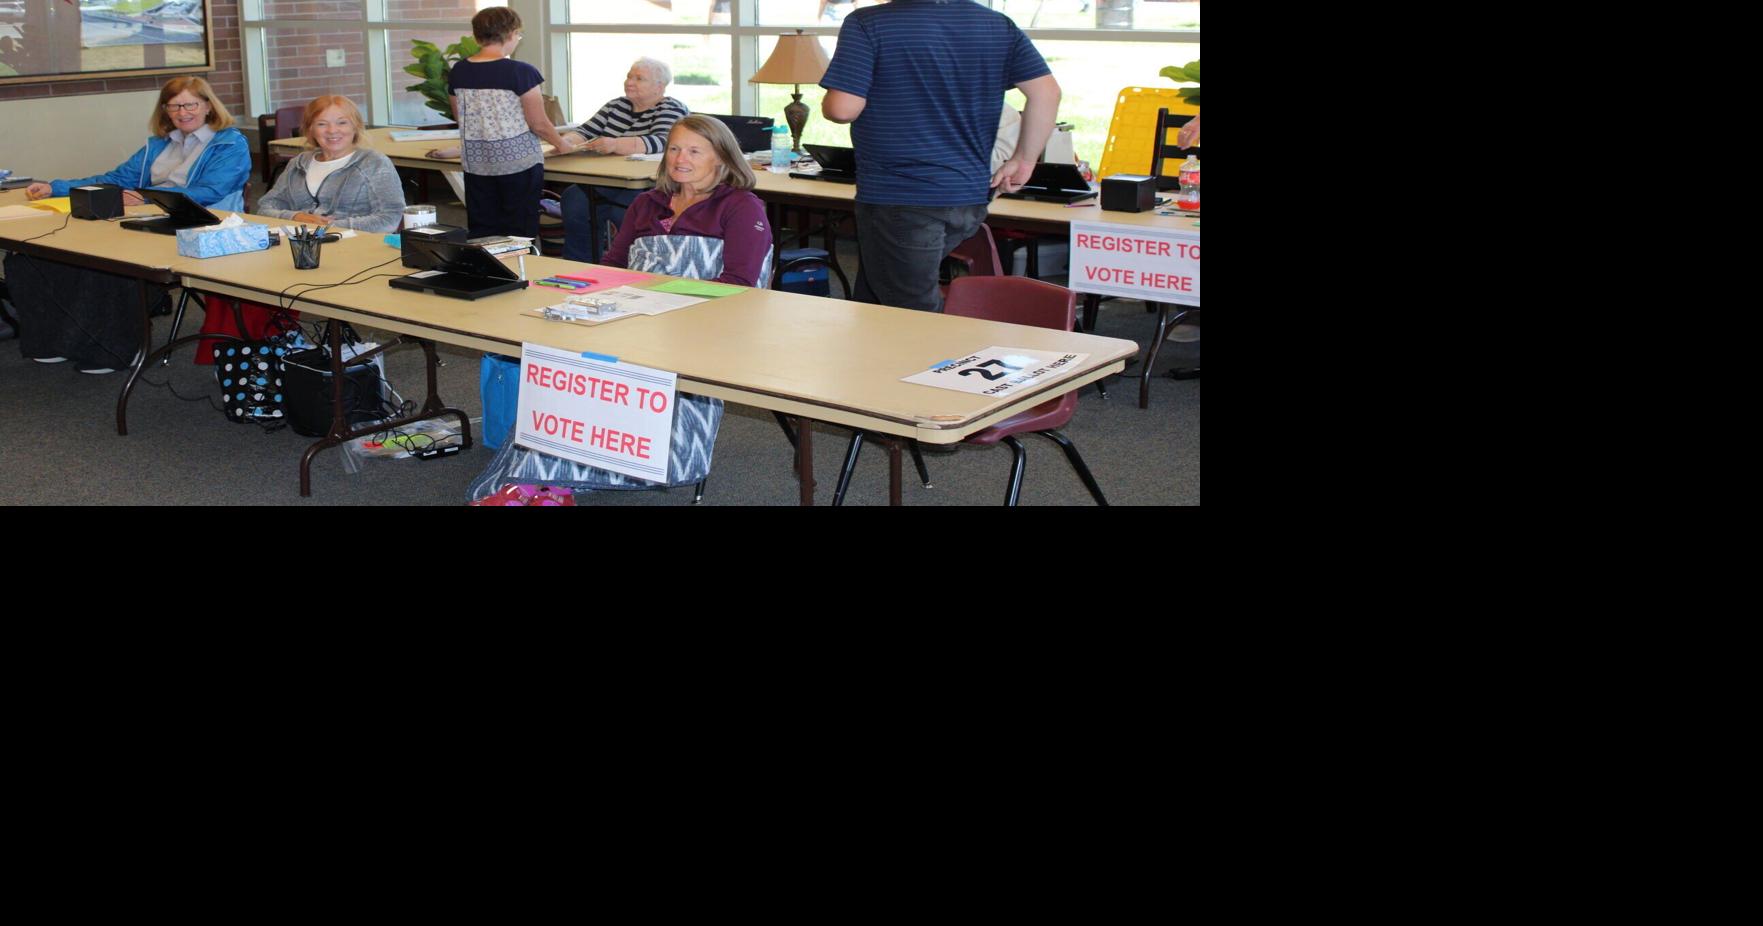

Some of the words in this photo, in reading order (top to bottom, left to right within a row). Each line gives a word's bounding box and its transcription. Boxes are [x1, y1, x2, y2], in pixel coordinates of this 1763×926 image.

[1077, 234, 1170, 256] REGISTER
[1177, 243, 1200, 260] TO
[1085, 266, 1134, 284] VOTE
[1140, 272, 1192, 291] HERE
[958, 359, 1024, 381] 27
[527, 364, 629, 406] REGISTER
[636, 387, 667, 413] TO
[532, 410, 584, 443] VOTE
[590, 426, 651, 459] HERE
